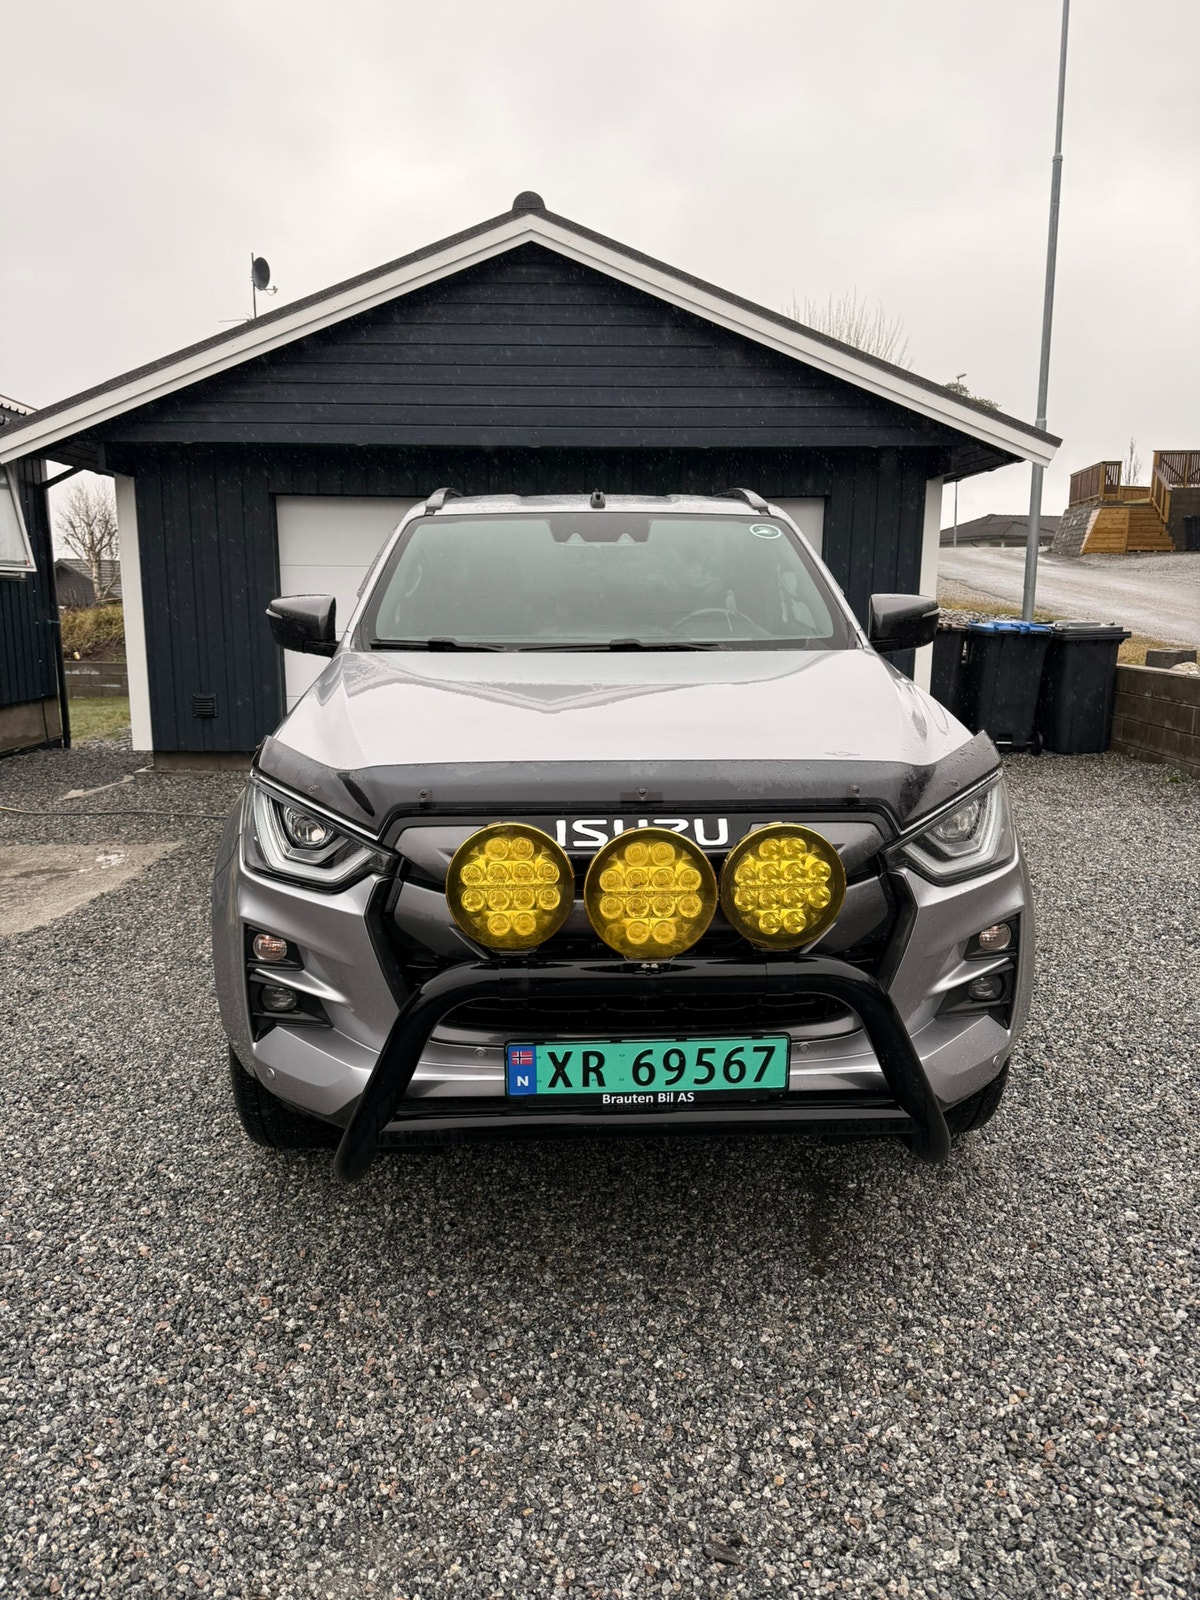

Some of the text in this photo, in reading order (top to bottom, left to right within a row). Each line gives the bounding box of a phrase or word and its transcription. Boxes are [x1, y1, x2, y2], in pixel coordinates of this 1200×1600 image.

[547, 1046, 776, 1088] XR 69567
[517, 1076, 529, 1087] N
[602, 1092, 695, 1104] Brauten Bil AS
